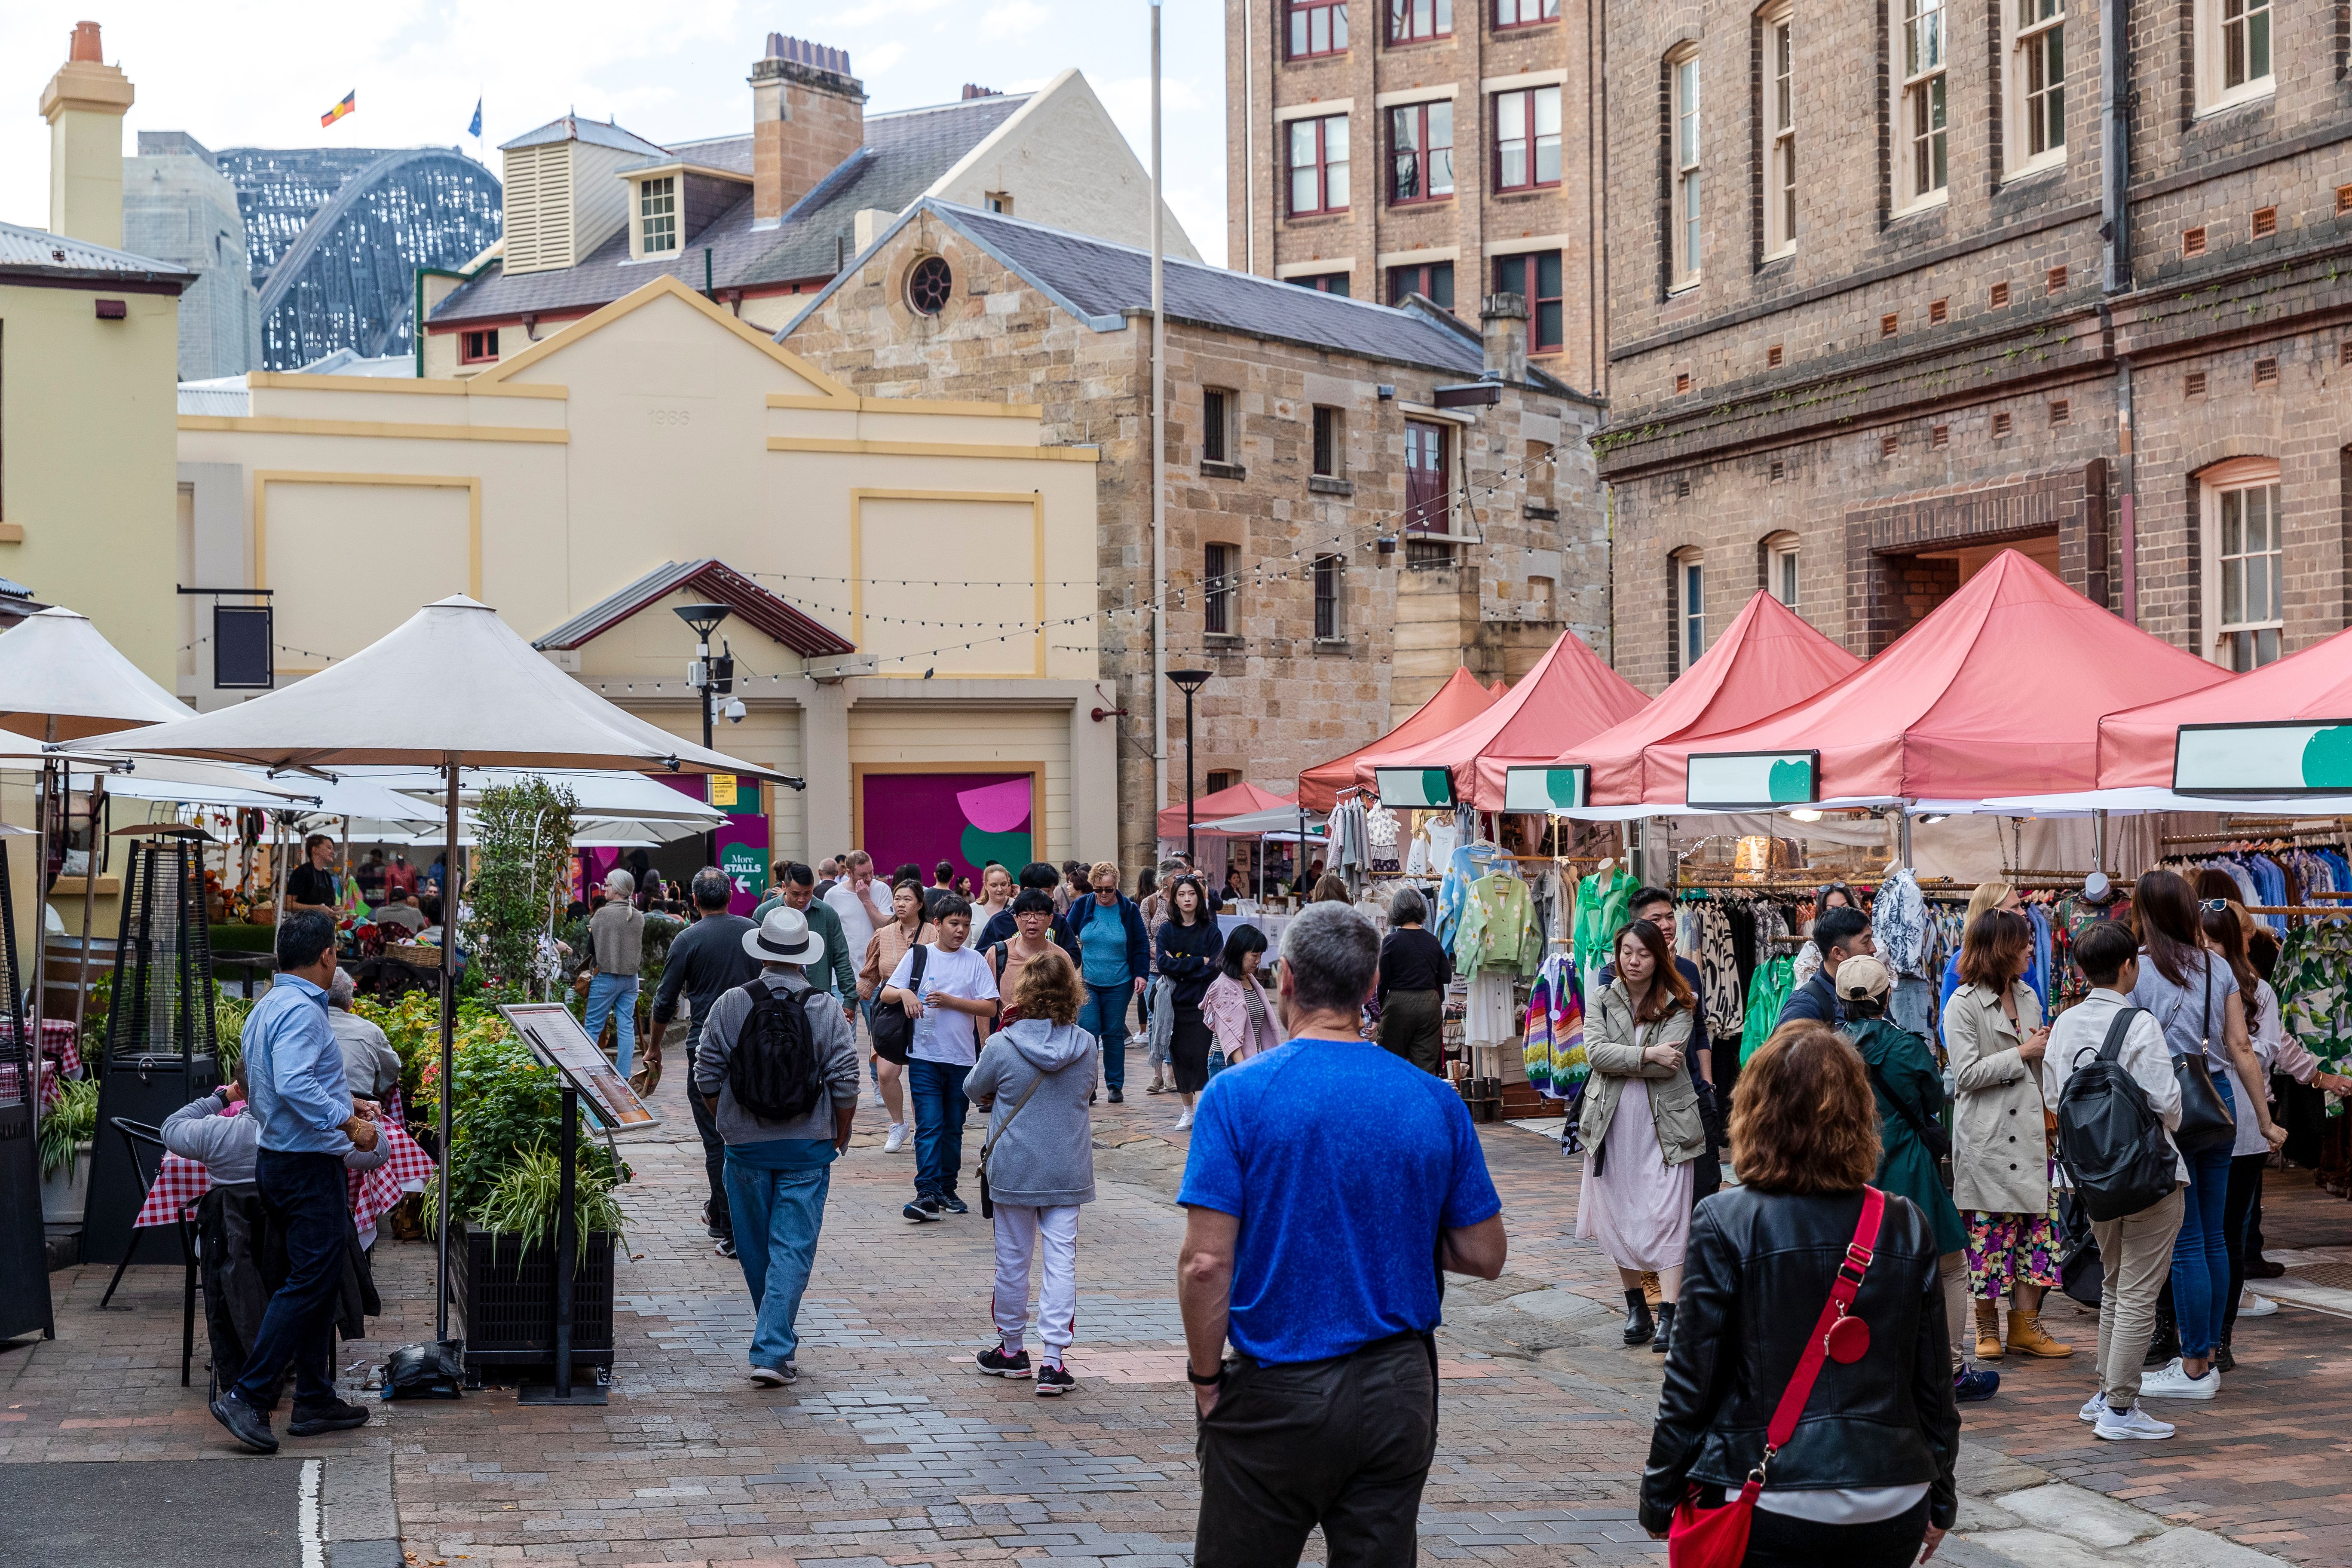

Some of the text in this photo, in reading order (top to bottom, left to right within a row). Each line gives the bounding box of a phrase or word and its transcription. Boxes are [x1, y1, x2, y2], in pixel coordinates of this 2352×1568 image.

[647, 410, 690, 426] 1986
[732, 854, 753, 863] More
[723, 864, 762, 873] STALLS
